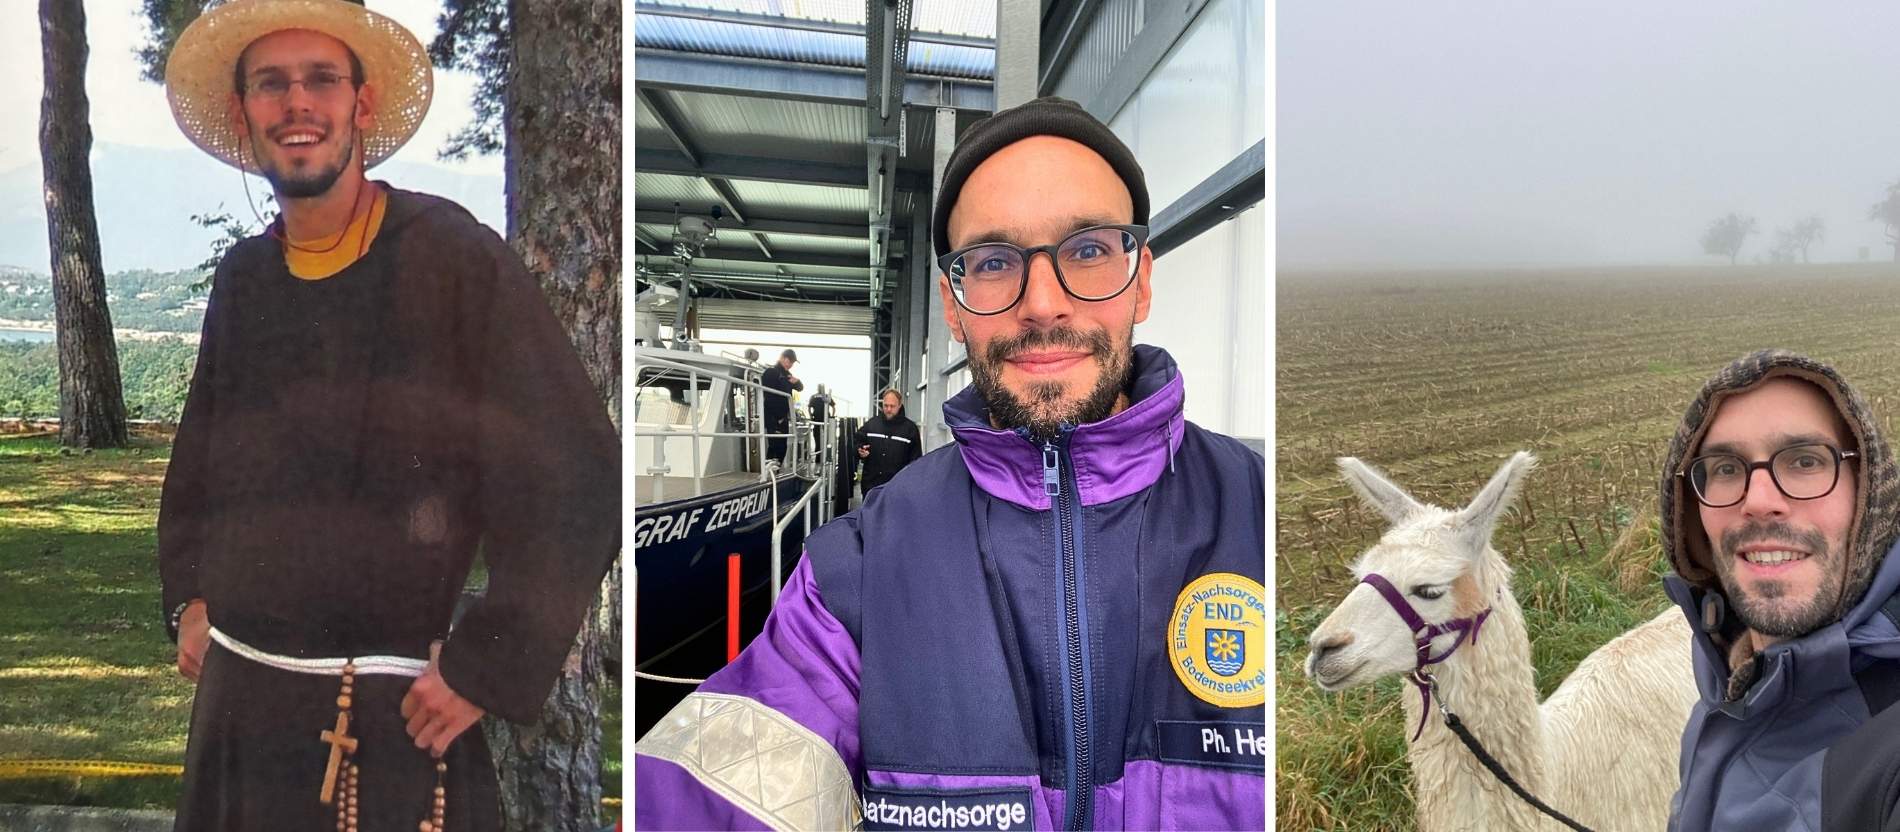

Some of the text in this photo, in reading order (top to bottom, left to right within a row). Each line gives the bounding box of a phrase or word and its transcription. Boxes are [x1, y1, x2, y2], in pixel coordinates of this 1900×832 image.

[635, 488, 770, 549] GRAF ZEPPELIN
[1176, 584, 1265, 650] Einsatz-Nachsorge
[1204, 602, 1243, 621] END
[1201, 728, 1231, 753] Ph.
[862, 794, 1026, 830] atznachsorge
